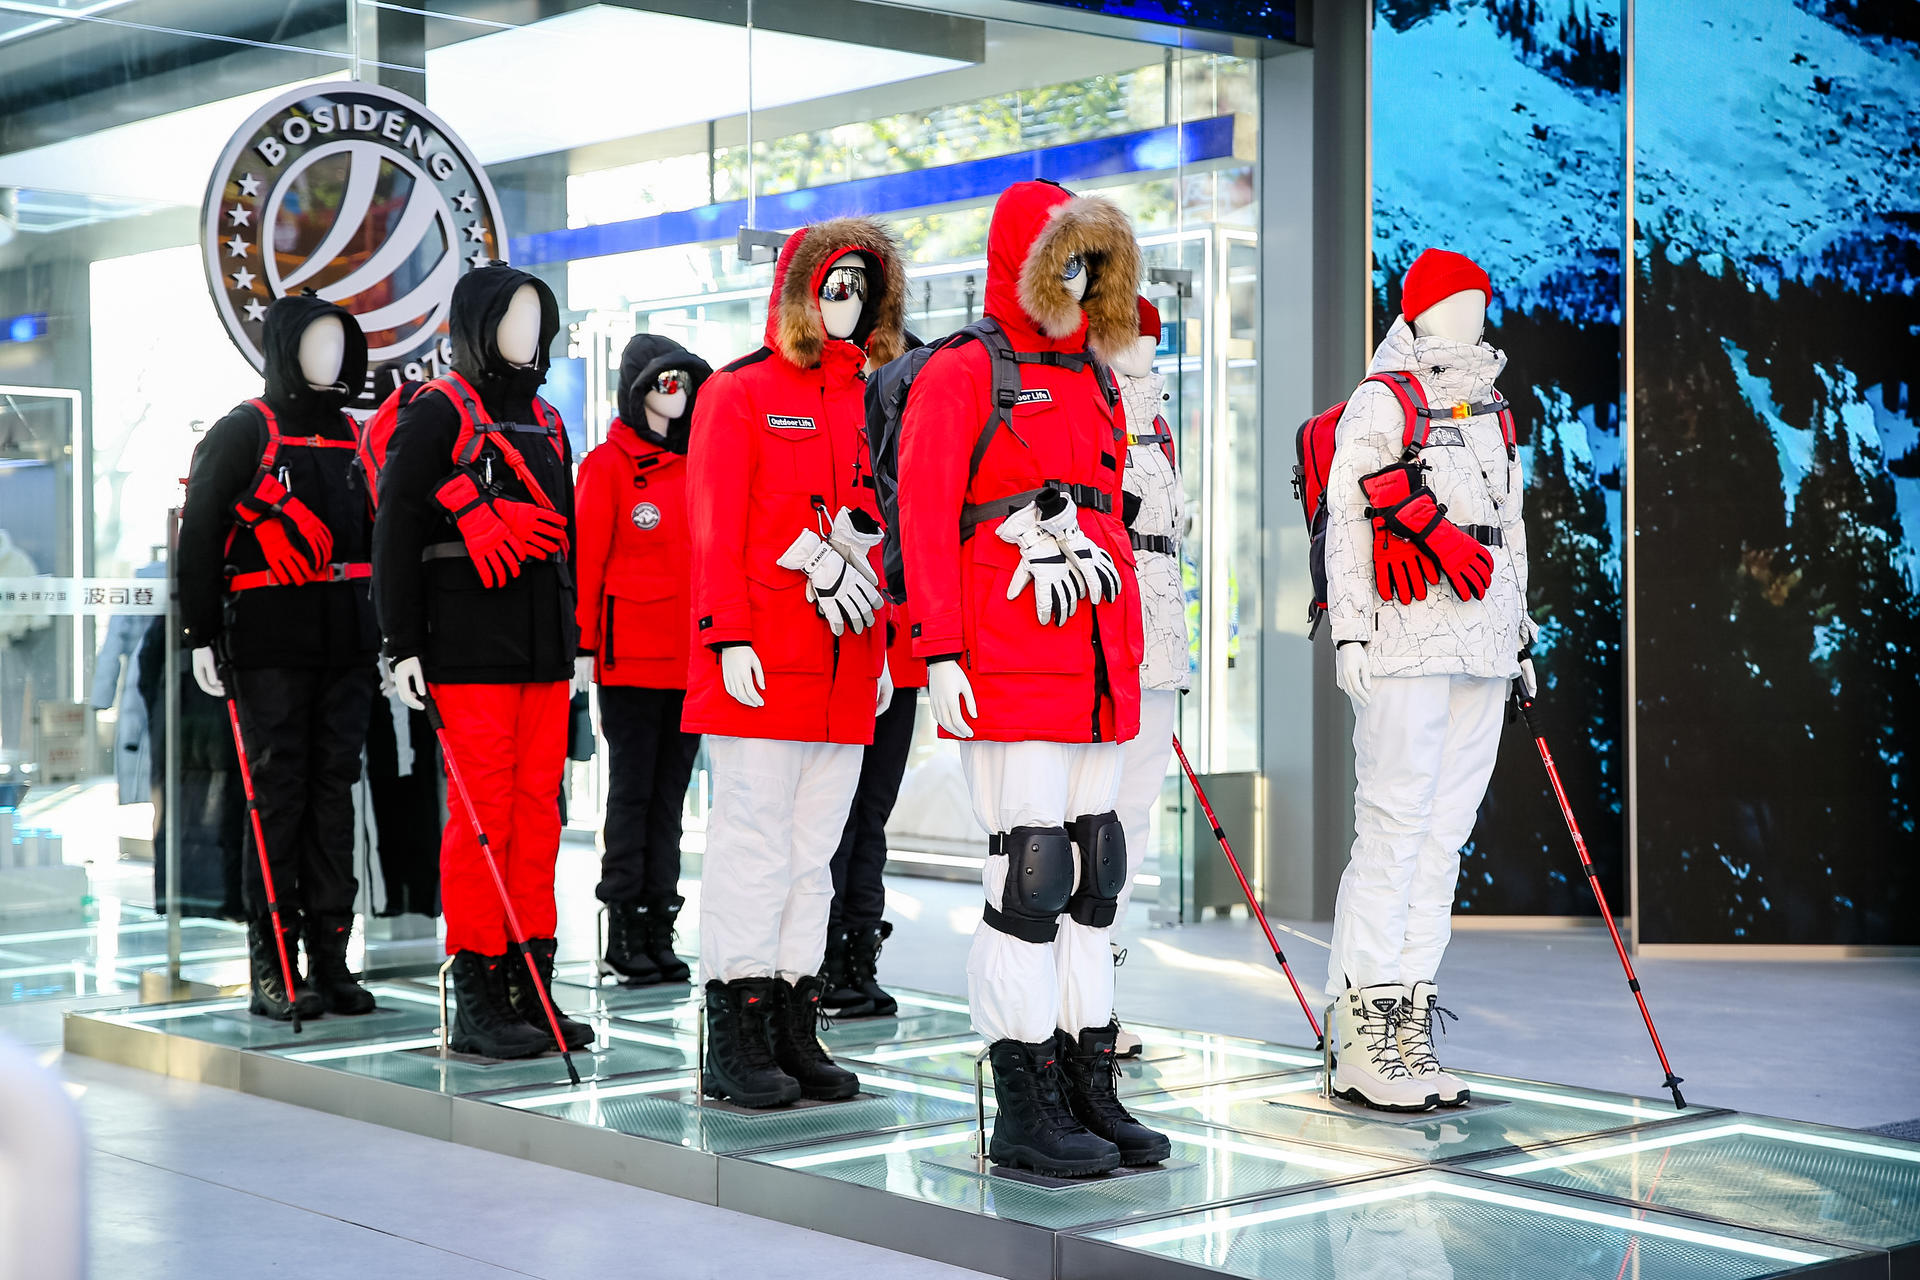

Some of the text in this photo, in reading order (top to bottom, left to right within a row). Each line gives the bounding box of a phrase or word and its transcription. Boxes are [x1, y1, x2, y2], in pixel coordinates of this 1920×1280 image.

[256, 103, 457, 181] BOSIDENG
[770, 417, 812, 427] Outdoor Life
[84, 587, 154, 605] 波司登
